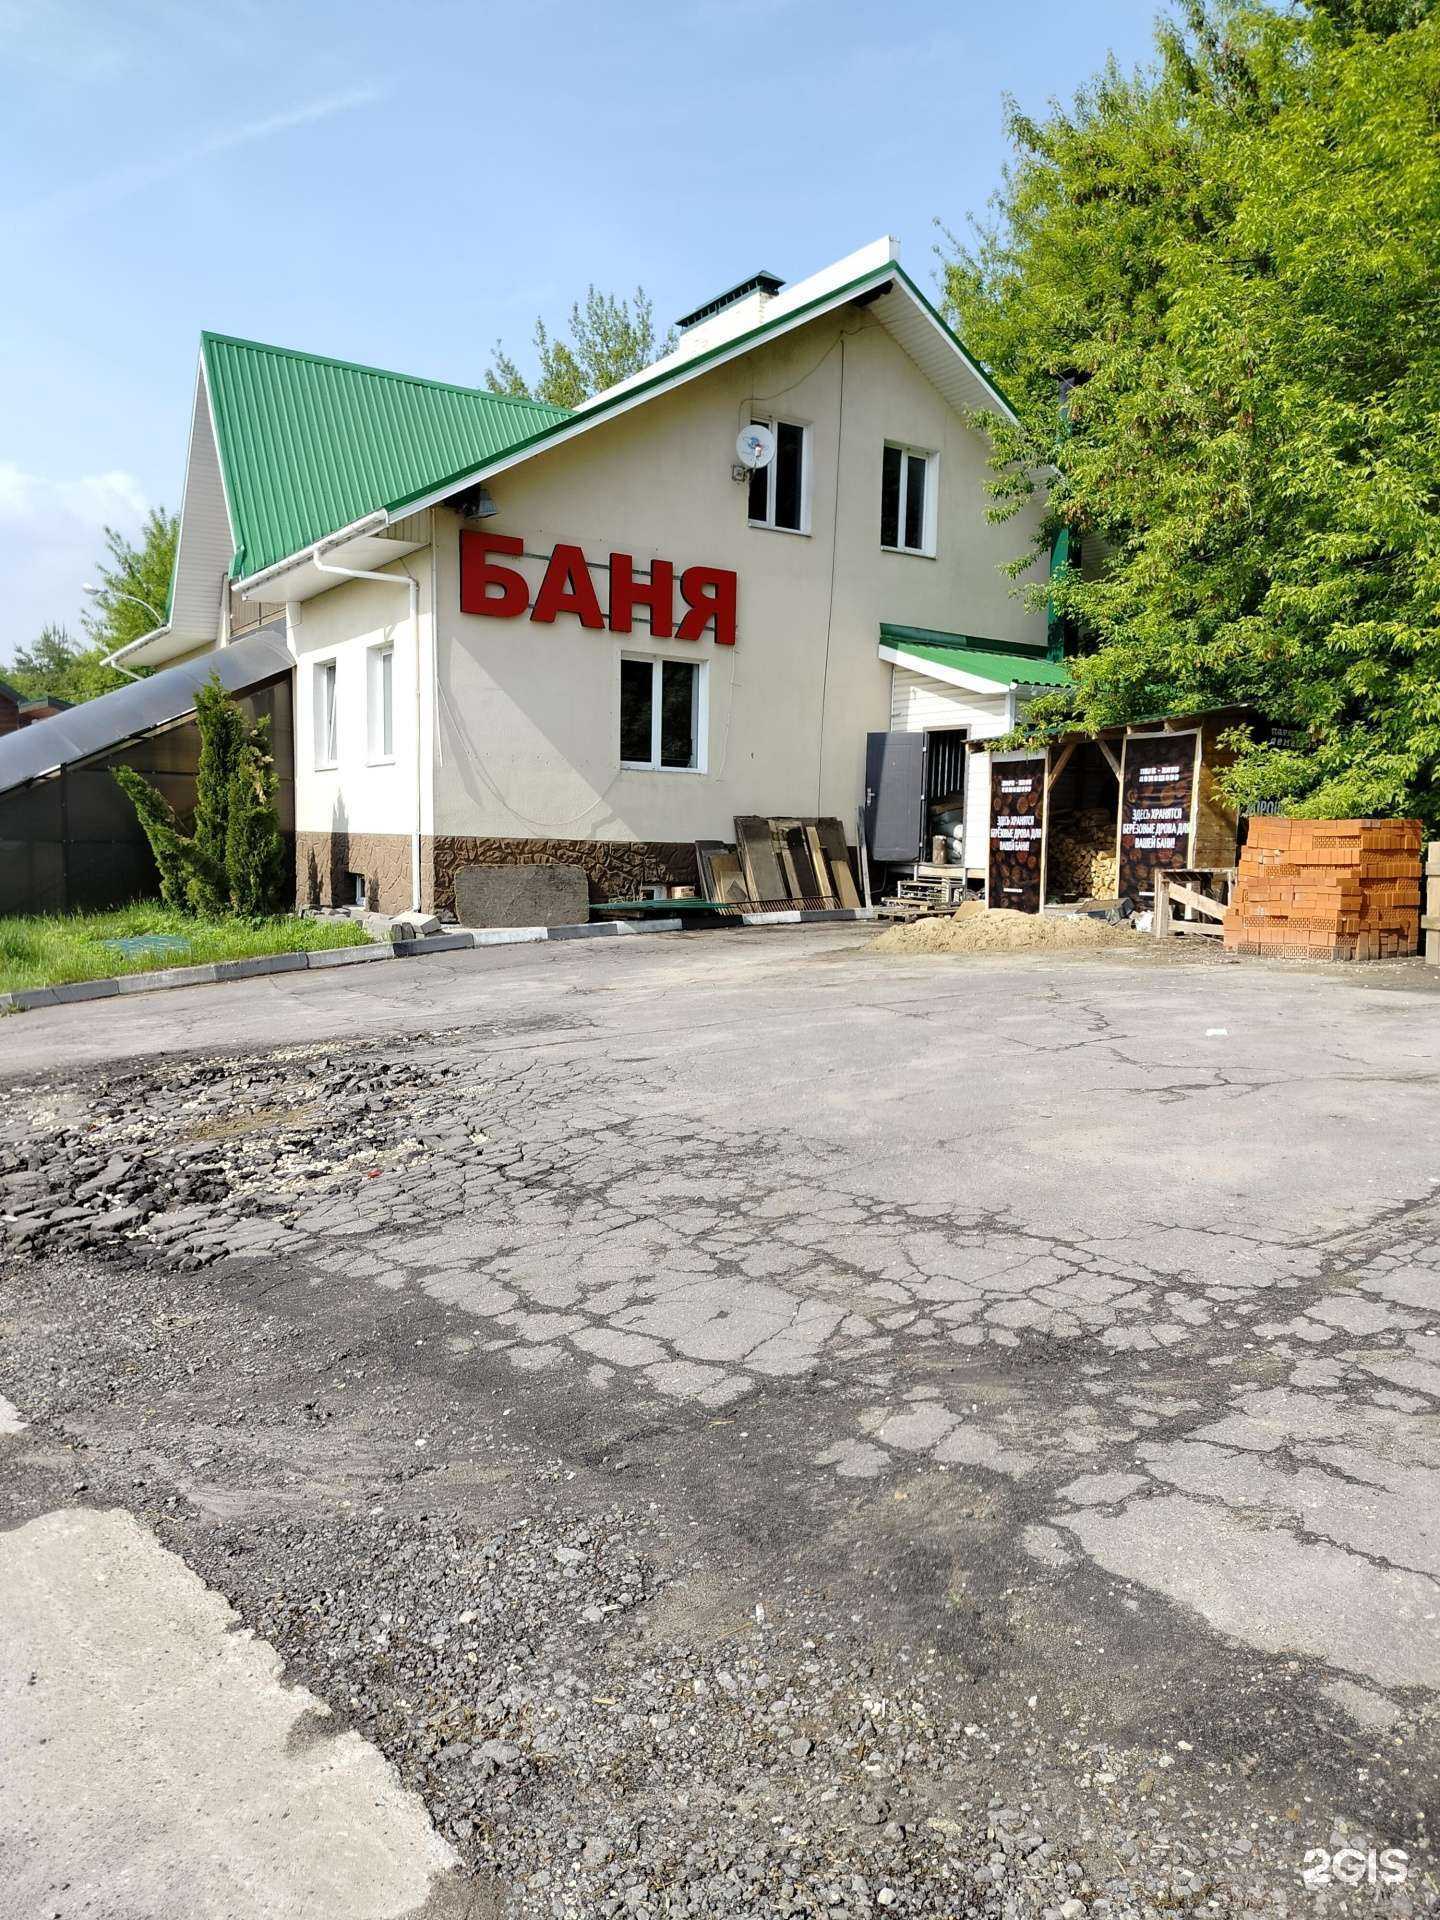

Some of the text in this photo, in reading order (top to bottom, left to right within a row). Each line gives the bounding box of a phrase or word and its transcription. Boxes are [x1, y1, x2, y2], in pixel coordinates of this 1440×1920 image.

[459, 529, 737, 645] БАНЯ
[1132, 808, 1182, 821] ЗДЕСЬ ХРАНЯТСЯ
[1122, 821, 1156, 834] БЕРЁЗОВЫЕ
[1155, 822, 1176, 836] ДРОВА
[1135, 835, 1156, 848] ВАШЕЙ
